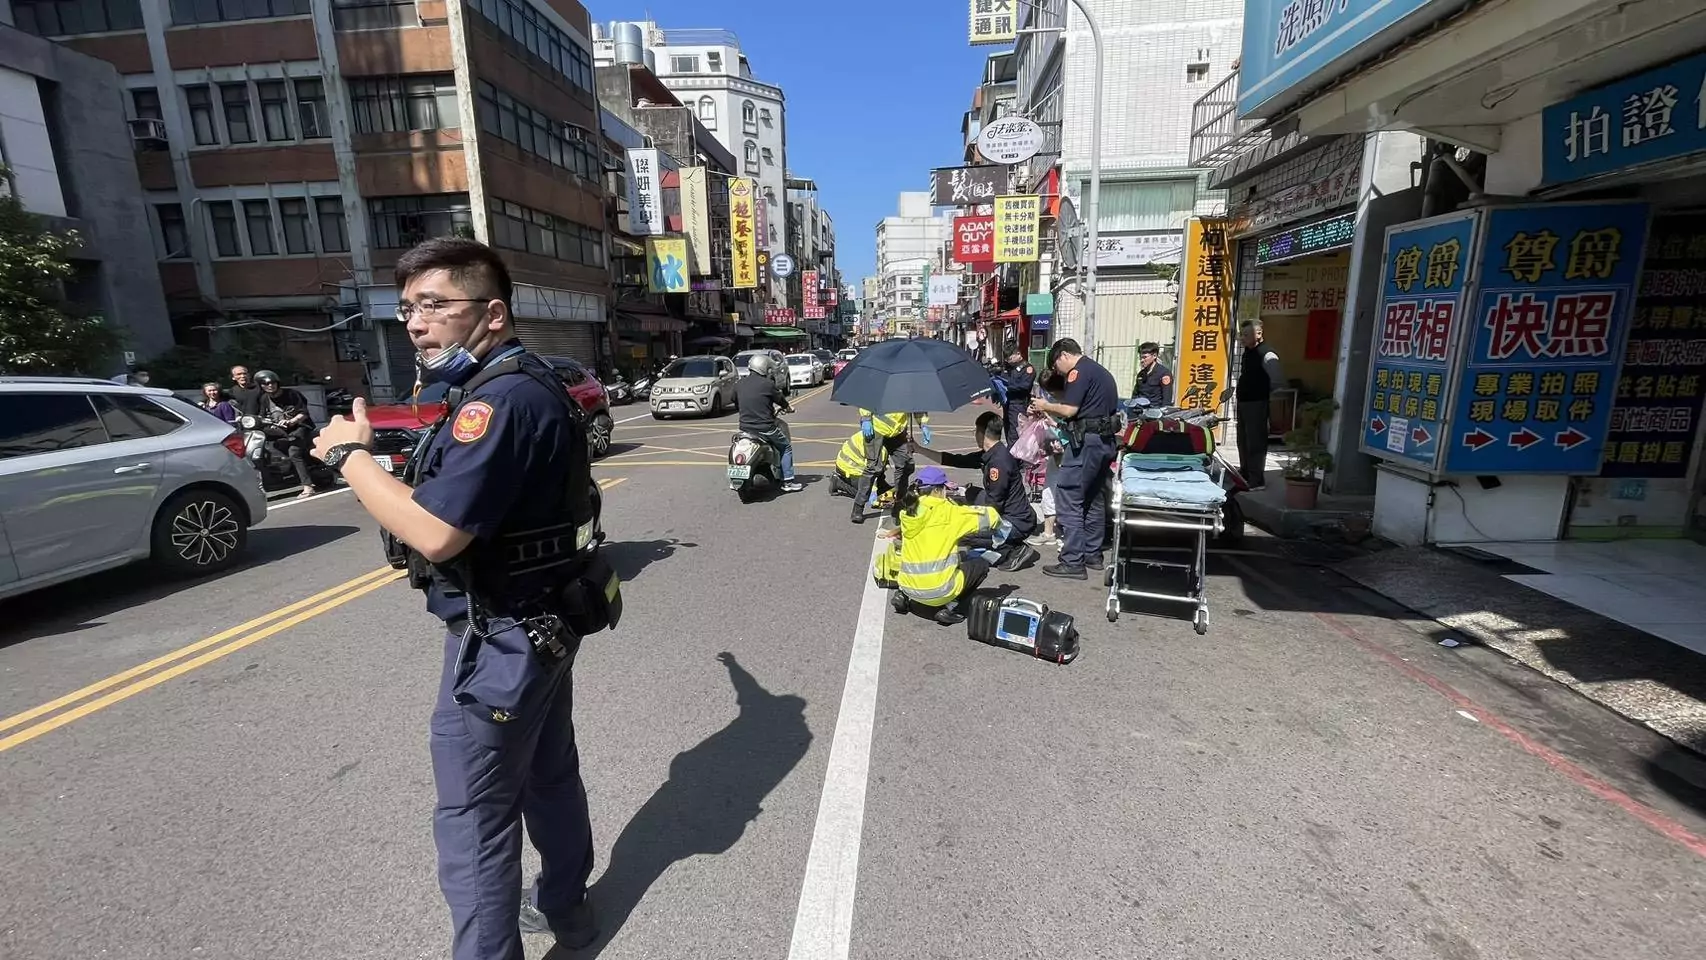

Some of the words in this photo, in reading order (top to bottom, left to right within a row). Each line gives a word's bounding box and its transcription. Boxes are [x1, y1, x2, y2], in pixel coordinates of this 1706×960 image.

[975, 16, 1012, 35] 通訊
[1564, 72, 1706, 162] 拍證
[1314, 191, 1339, 208] Digital
[959, 221, 993, 232] ADAM
[1392, 238, 1461, 292] 尊爵
[1500, 228, 1623, 282] 尊爵
[1263, 289, 1298, 310] 照相
[1380, 299, 1456, 361] 照相
[1487, 292, 1617, 359] 快照
[1377, 369, 1442, 395] 現拍現看
[1474, 371, 1600, 397] 專業拍照
[1373, 392, 1438, 422] 品質保證
[1470, 399, 1595, 424] 現場取件
